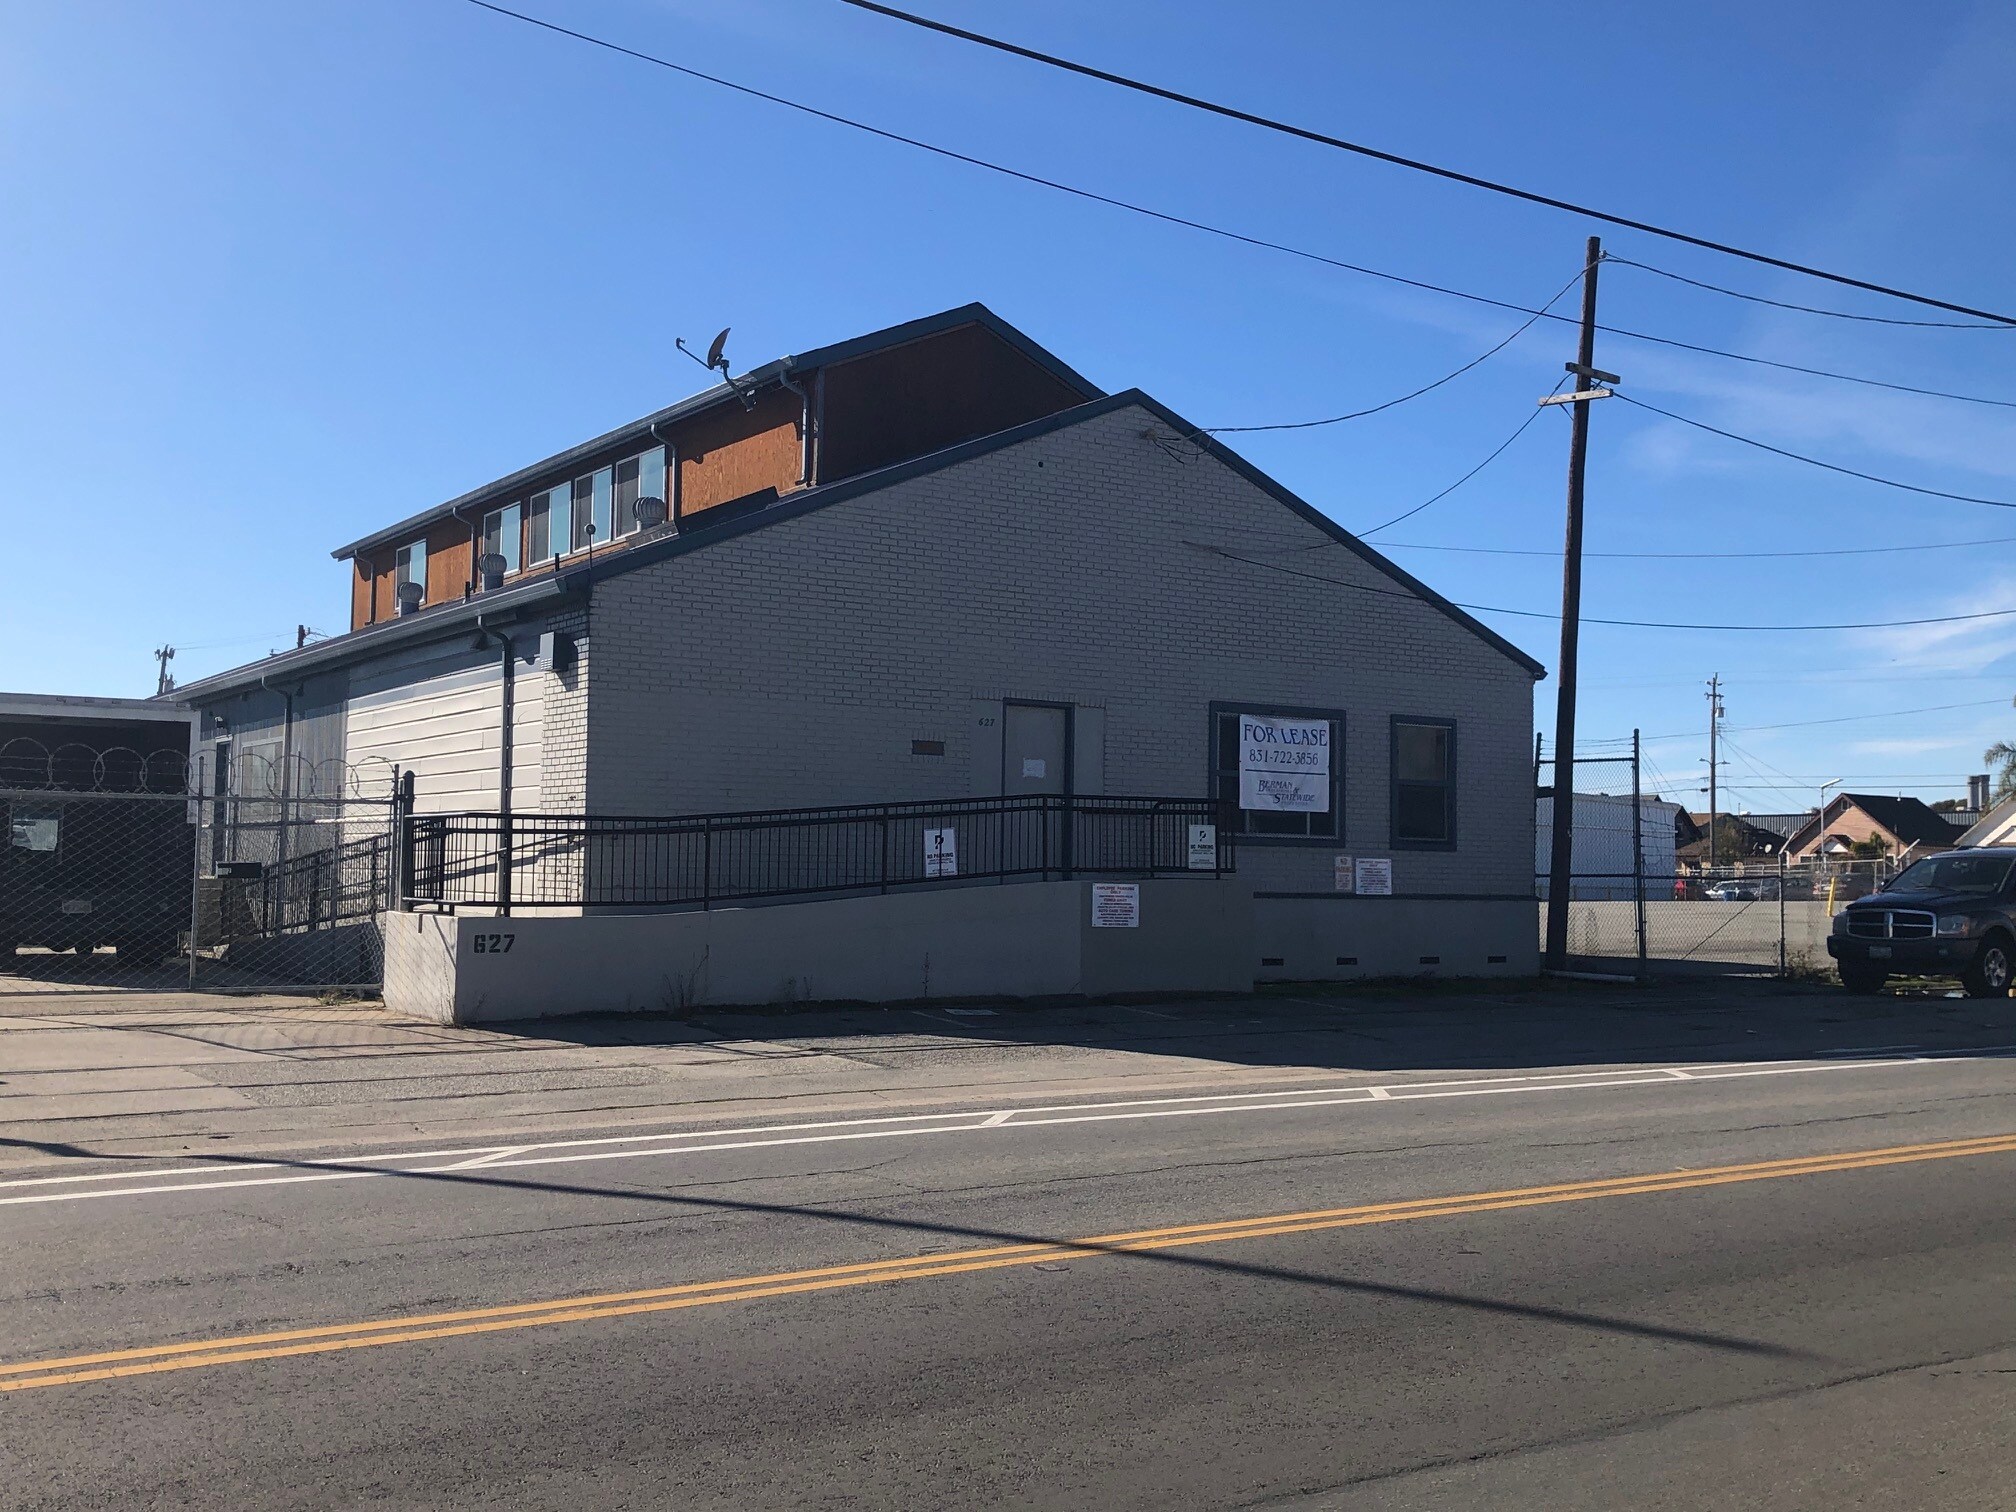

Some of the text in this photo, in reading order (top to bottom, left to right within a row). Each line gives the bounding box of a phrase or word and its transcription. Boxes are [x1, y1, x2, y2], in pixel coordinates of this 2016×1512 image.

[978, 717, 996, 727] 627
[1243, 724, 1328, 747] FOR LEASE
[1249, 749, 1319, 766] 831-722-3856
[1258, 780, 1293, 792] BERMAN
[1273, 793, 1315, 804] STATEWIDE
[474, 934, 515, 953] 627
